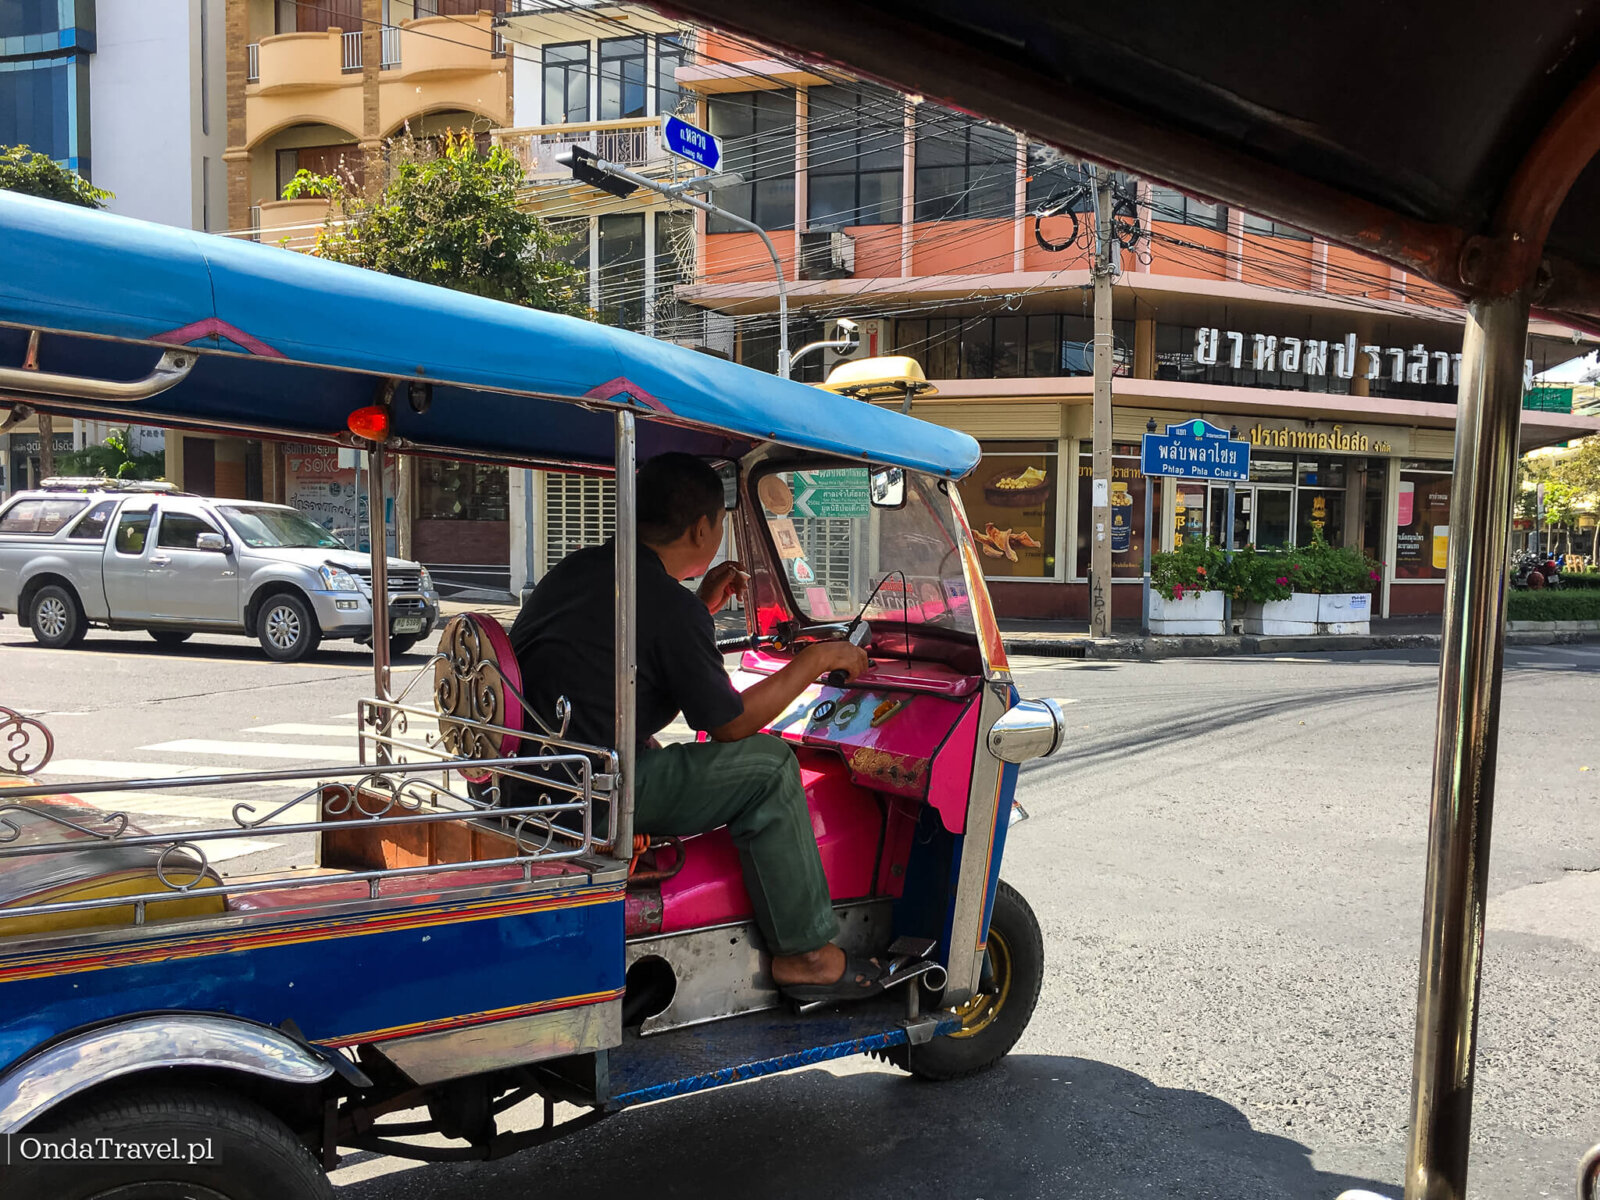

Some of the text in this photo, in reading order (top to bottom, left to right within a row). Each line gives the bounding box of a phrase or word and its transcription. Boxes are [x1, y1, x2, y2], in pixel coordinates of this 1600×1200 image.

[680, 127, 706, 151] ถ.หลวง
[682, 145, 696, 160] Luang
[1250, 423, 1369, 451] ปราสาททองโอสถ
[1158, 440, 1237, 464] พลับพลาไชย
[1162, 464, 1232, 477] Phlap Phla Chai
